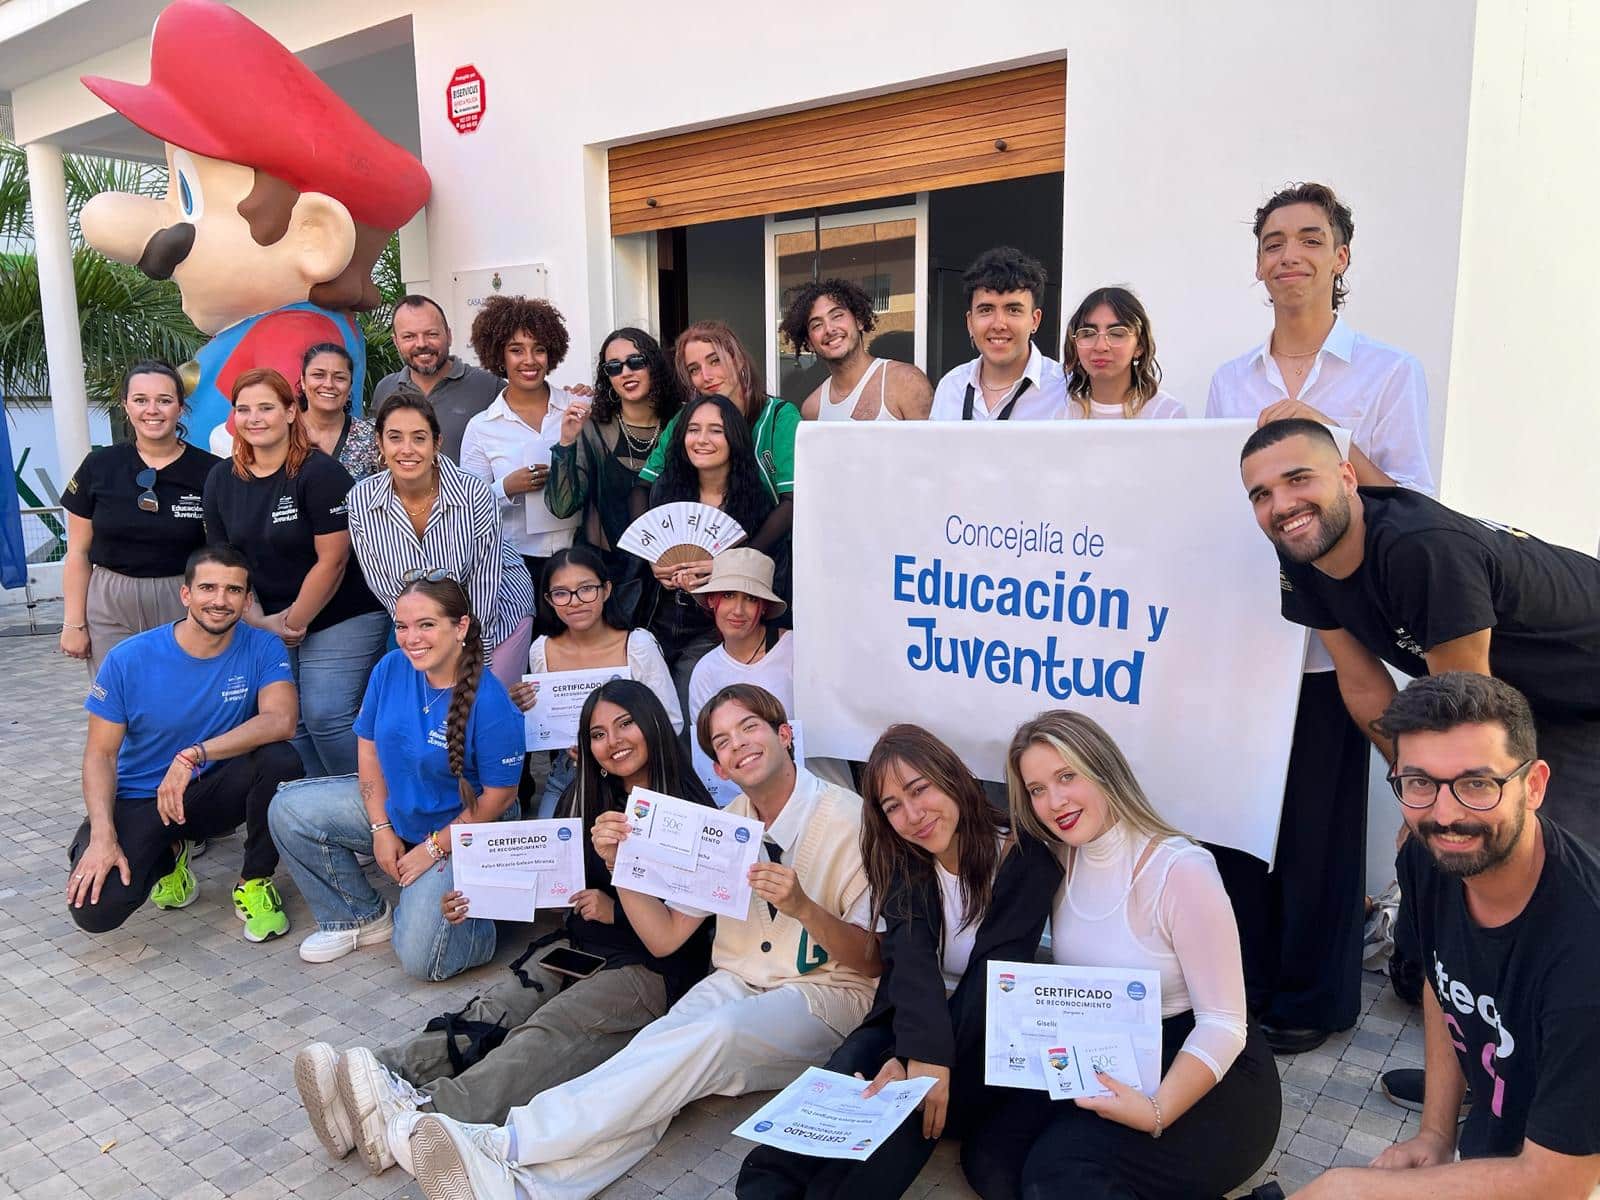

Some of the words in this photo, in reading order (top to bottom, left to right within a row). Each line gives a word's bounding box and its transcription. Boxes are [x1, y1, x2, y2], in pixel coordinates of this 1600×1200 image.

[945, 514, 1063, 558] Concejalía
[1073, 525, 1105, 557] de
[894, 554, 1130, 630] Educación
[1148, 604, 1170, 642] y
[906, 617, 1145, 705] Juventud
[552, 682, 602, 692] CERTIFICADO
[487, 835, 548, 847] CERTIFICADO
[1034, 986, 1113, 1000] CERTIFICADO
[1046, 999, 1112, 1009] RECONOCIMIENTO
[783, 1126, 847, 1143] CERTIFICADO
